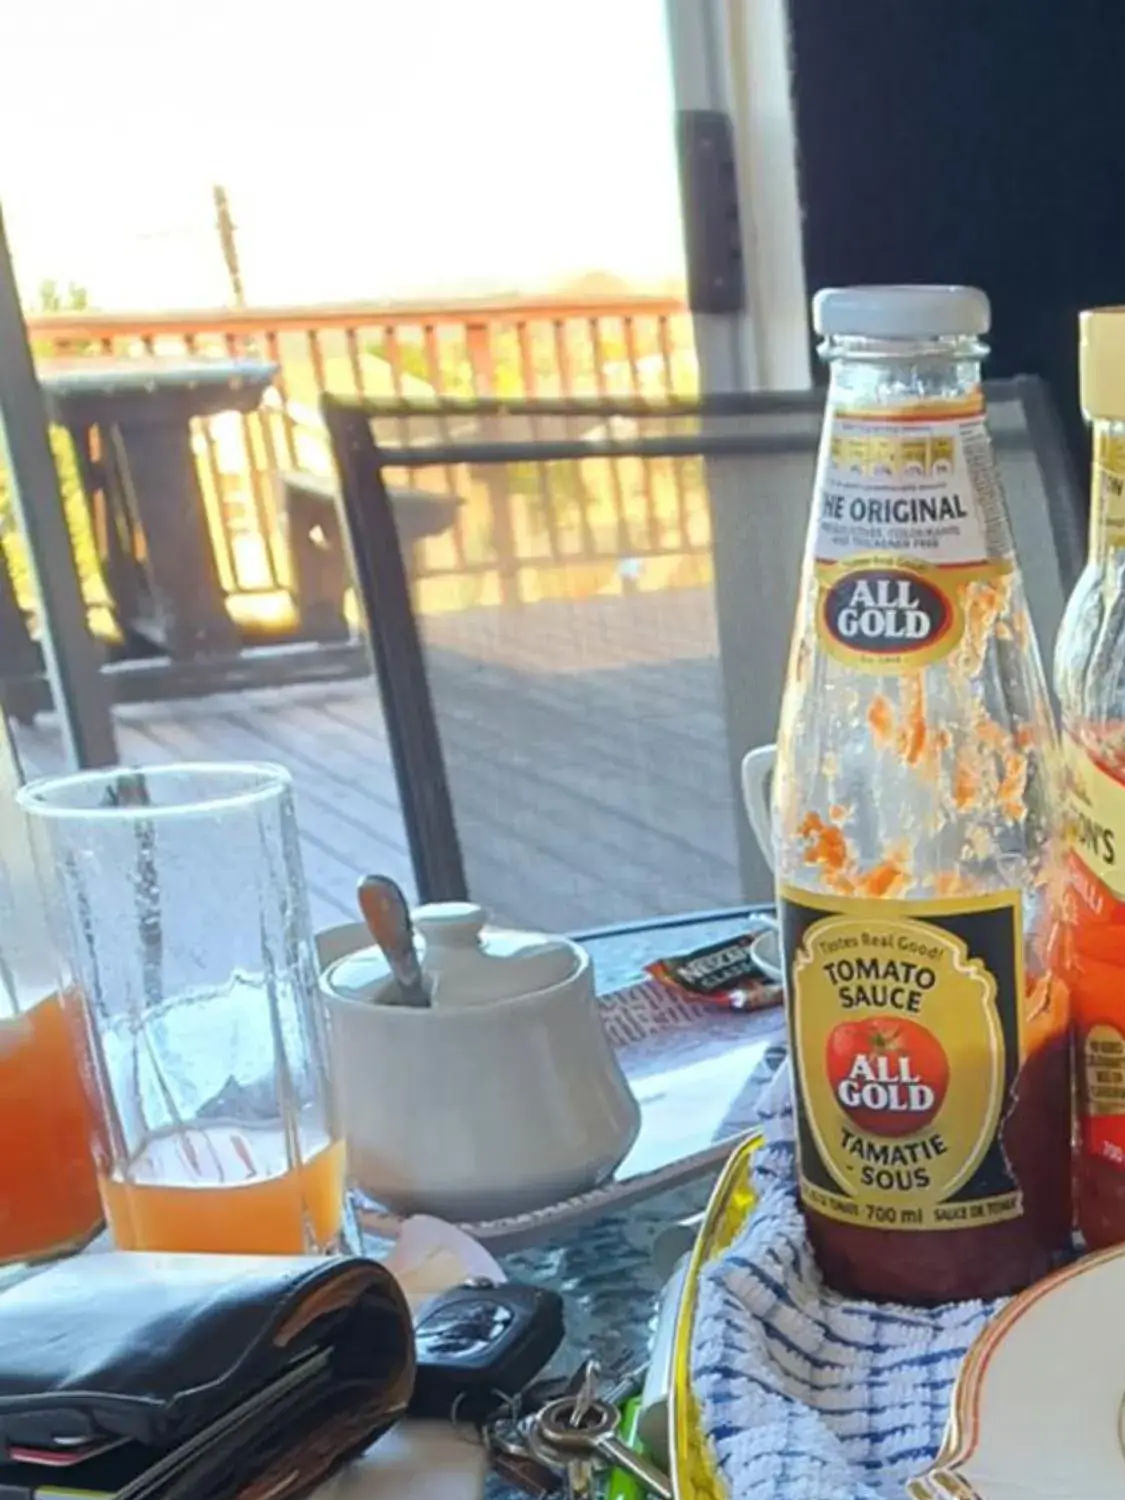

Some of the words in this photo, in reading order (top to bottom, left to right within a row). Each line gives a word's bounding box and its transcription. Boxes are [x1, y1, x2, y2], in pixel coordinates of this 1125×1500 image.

[850, 494, 968, 524] ORIGINAL
[849, 579, 920, 609] ALL
[837, 608, 931, 639] GOLD
[861, 932, 894, 949] Real
[823, 957, 936, 990] TOMATO
[839, 984, 922, 1014] SAUCE
[849, 1053, 921, 1084] ALL
[838, 1080, 935, 1112] GOLD
[841, 1126, 948, 1166] TAMATIE
[866, 1204, 896, 1224] 700
[901, 1207, 924, 1224] ml
